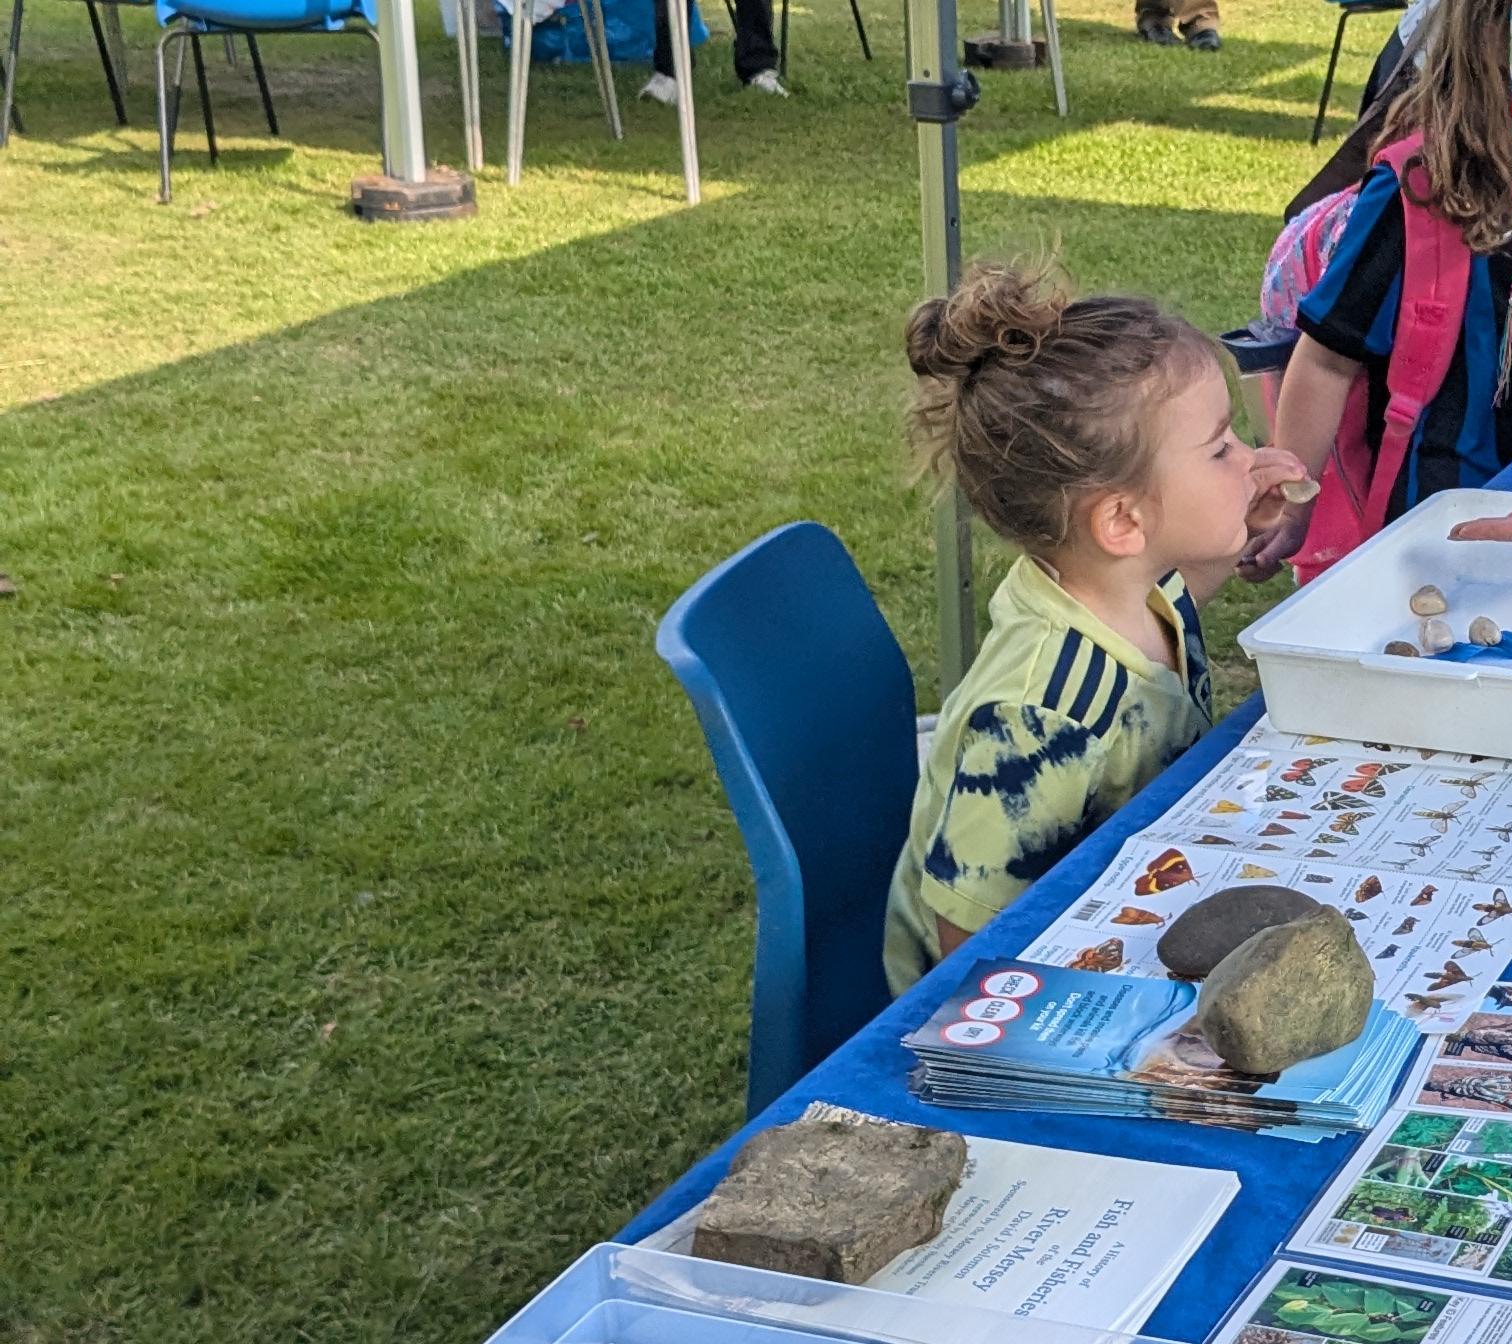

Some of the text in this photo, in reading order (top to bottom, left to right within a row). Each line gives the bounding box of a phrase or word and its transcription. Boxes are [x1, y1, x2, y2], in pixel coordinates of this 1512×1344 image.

[922, 1180, 1027, 1280] Sponsored by the Mersey Rivers
[953, 1210, 1033, 1279] David J Solomon
[973, 1207, 1071, 1293] River Mersey
[1014, 1198, 1135, 1317] Fish and Fisheries
[1035, 1244, 1061, 1266] of the
[1078, 1241, 1125, 1289] A History of
[1427, 1313, 1451, 1341] Features
[1445, 1294, 1463, 1309] Key
